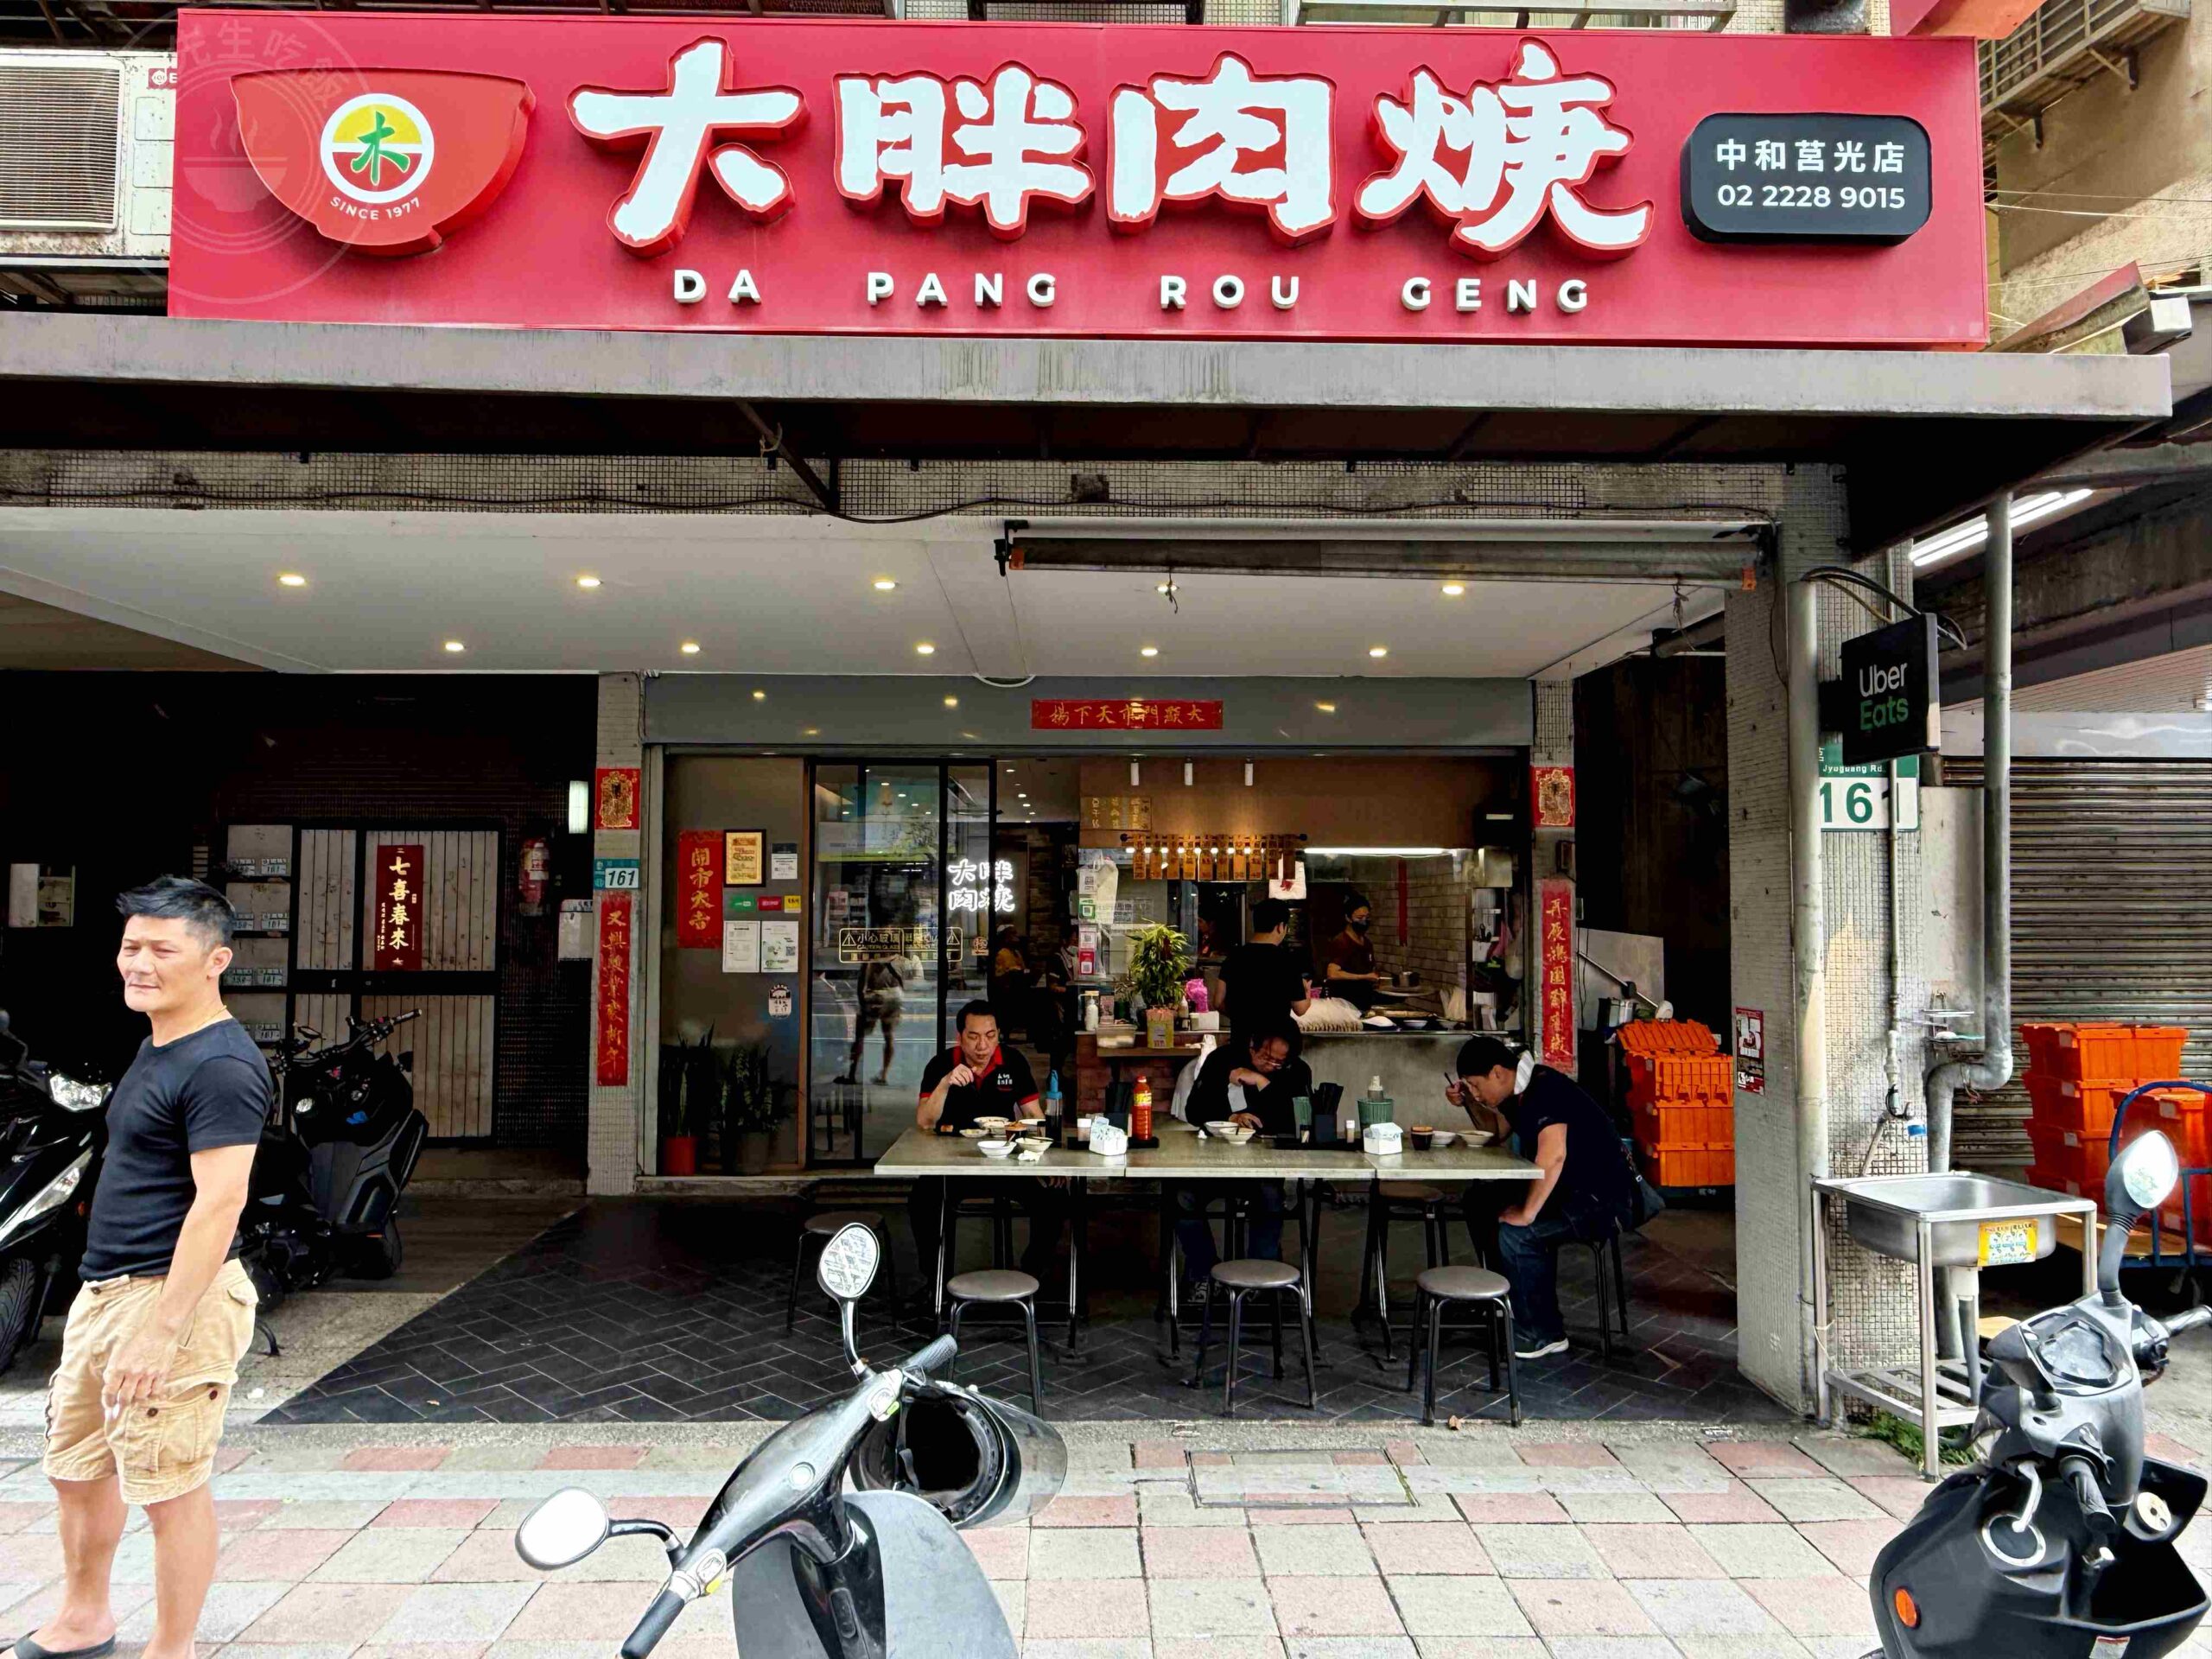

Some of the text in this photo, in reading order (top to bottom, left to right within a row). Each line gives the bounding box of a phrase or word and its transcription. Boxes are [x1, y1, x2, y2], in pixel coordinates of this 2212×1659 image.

[571, 41, 1649, 250] 大胖肉焿
[1716, 137, 1905, 175] 中和莒光店
[330, 196, 420, 220] SINCE 1977
[1717, 184, 1905, 210] 02 2228 9015
[673, 269, 1587, 314] DA PANG ROU GENG
[1859, 661, 1908, 697] Uber
[1859, 695, 1909, 731] Eats
[607, 869, 636, 887] 161
